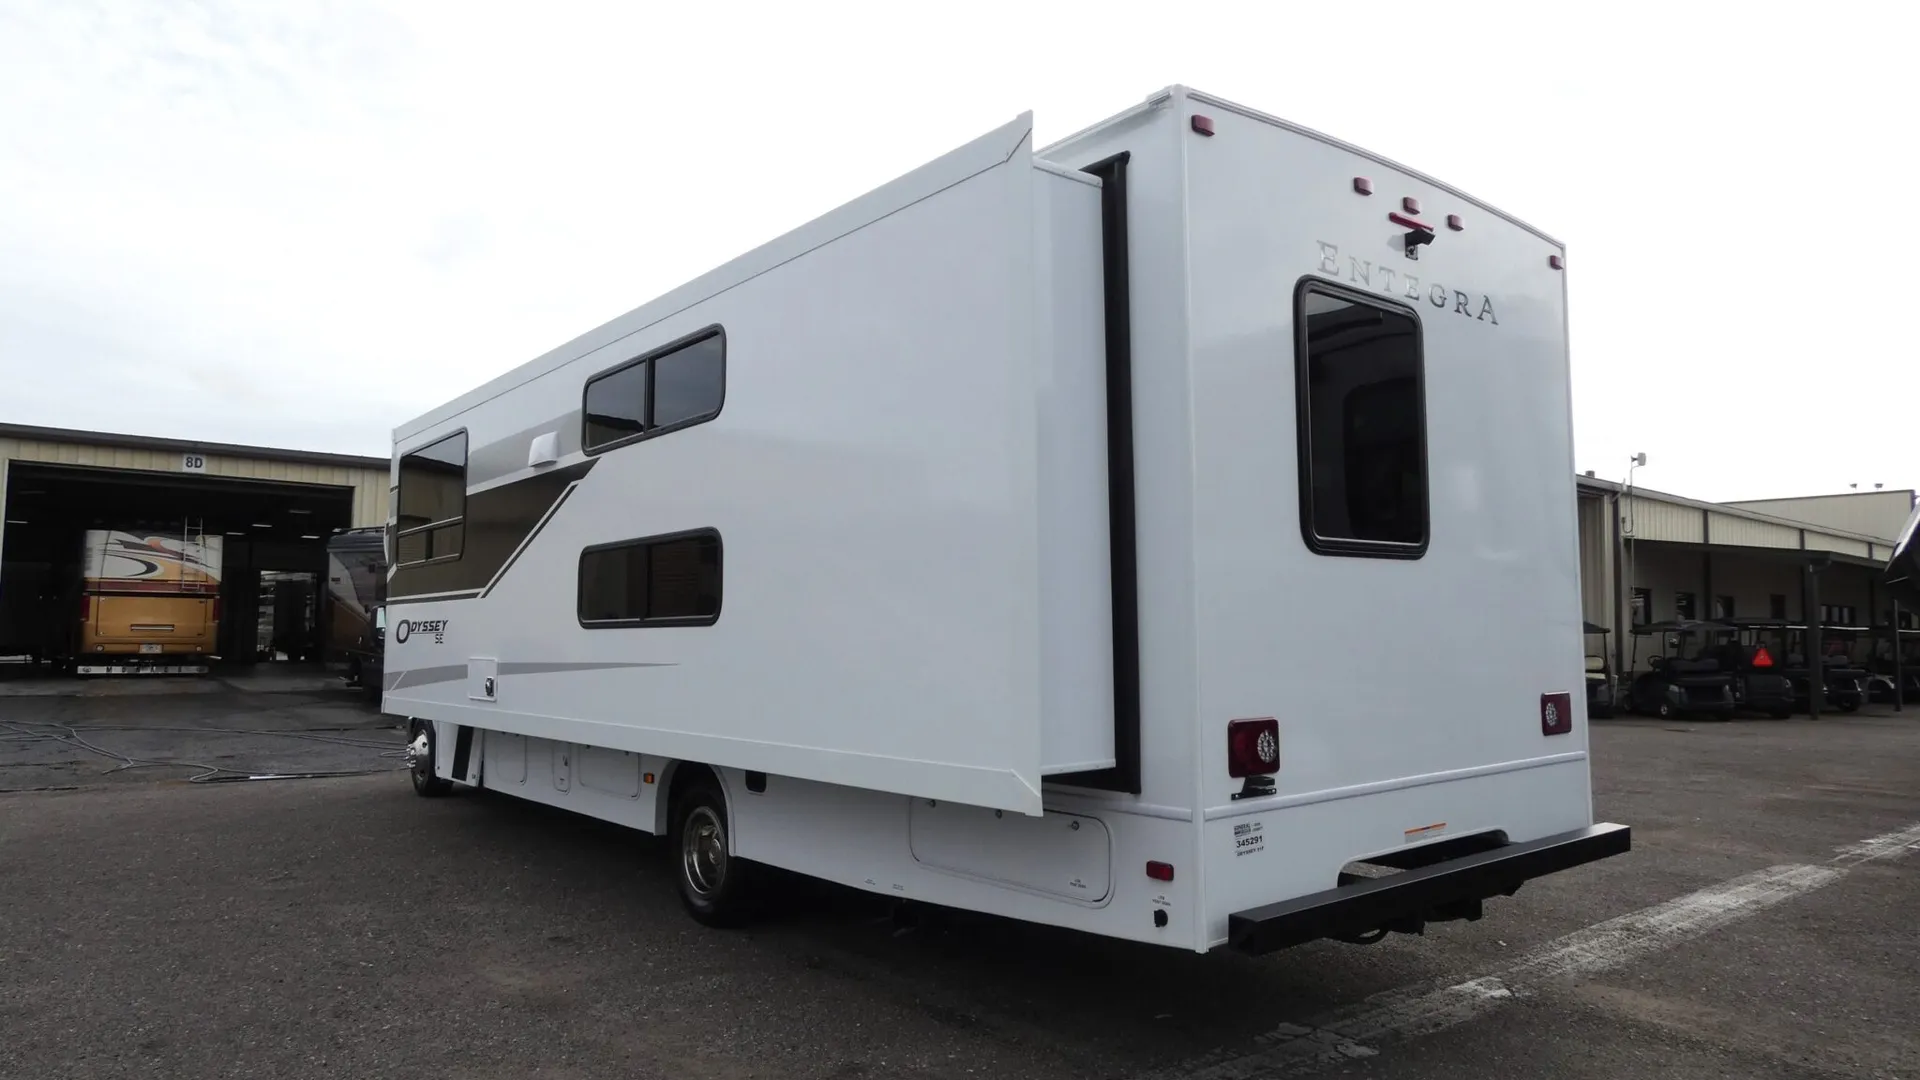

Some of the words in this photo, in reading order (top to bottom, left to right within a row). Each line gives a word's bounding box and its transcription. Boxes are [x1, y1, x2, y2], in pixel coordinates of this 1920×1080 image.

[1316, 239, 1499, 326] ENTEGRA
[185, 456, 203, 469] 8D
[396, 619, 449, 644] ODYSSEY
[435, 633, 444, 644] SE
[1236, 835, 1263, 848] 345291
